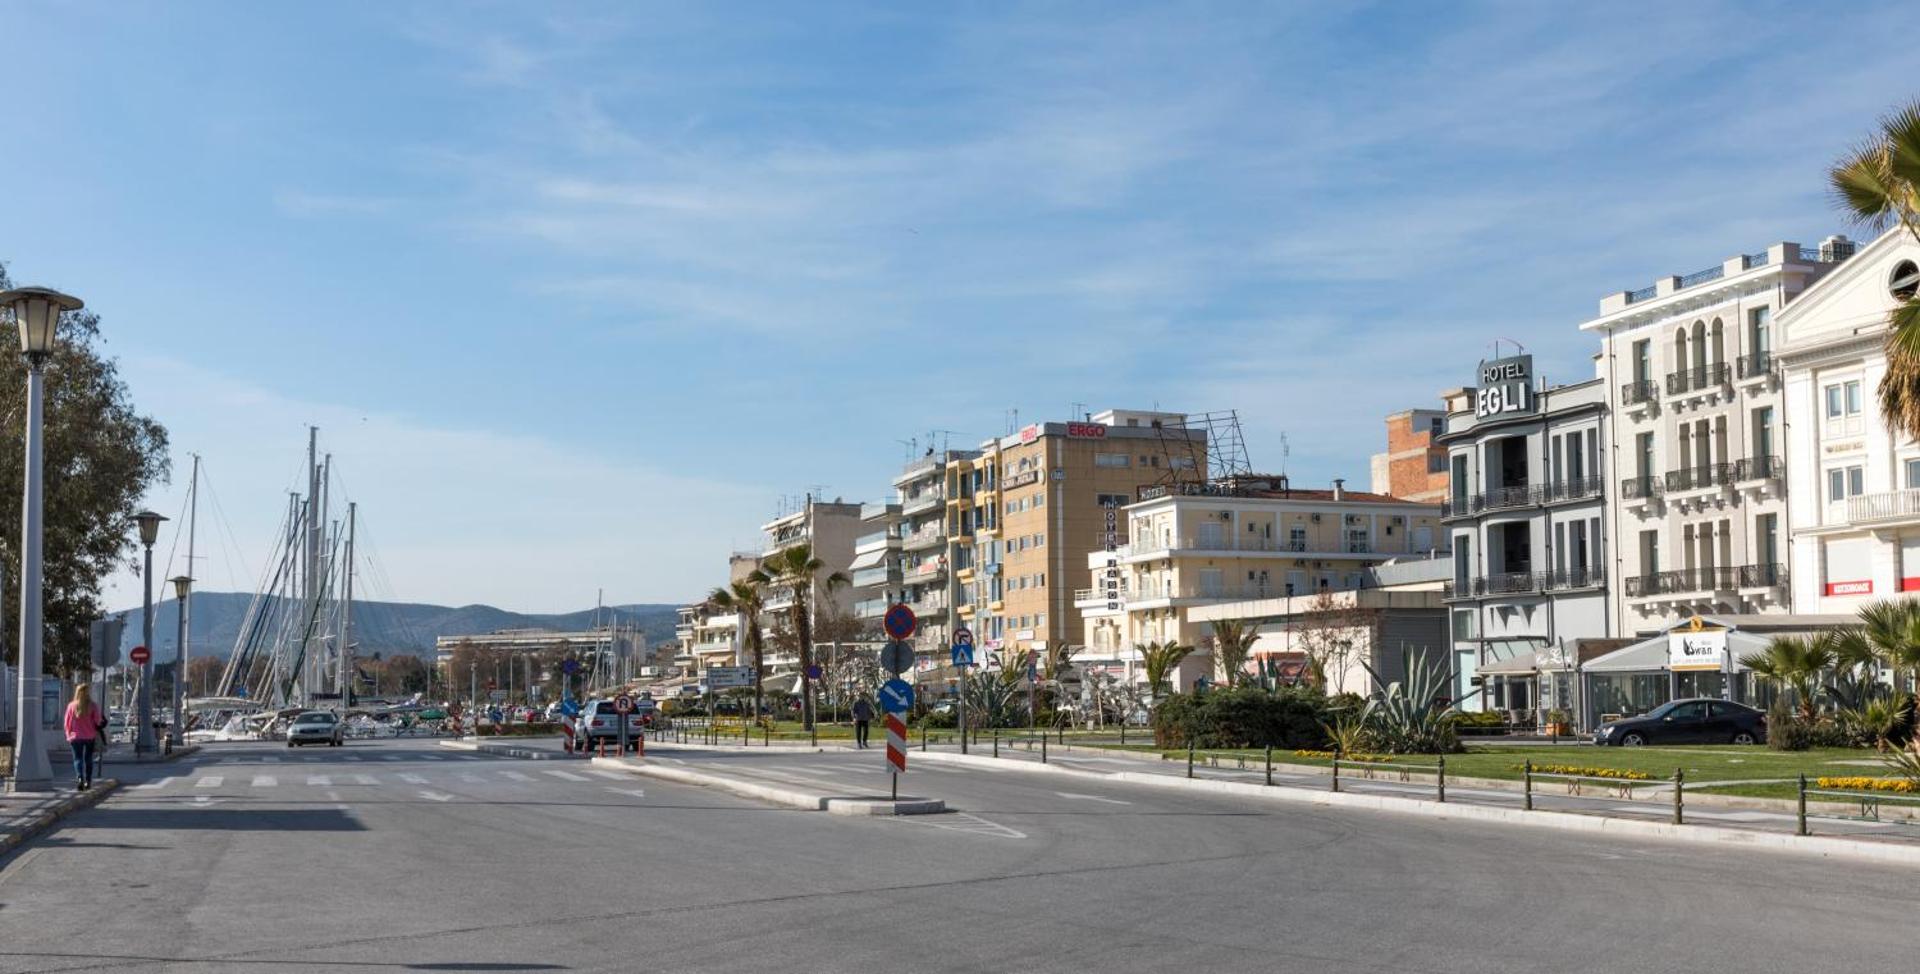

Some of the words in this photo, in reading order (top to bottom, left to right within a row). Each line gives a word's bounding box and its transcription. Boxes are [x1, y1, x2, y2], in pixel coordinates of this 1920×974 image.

[1483, 362, 1524, 383] HOTEL
[1068, 424, 1105, 437] ERGO
[1105, 501, 1116, 552] HOTEL
[1107, 560, 1118, 610] JASON
